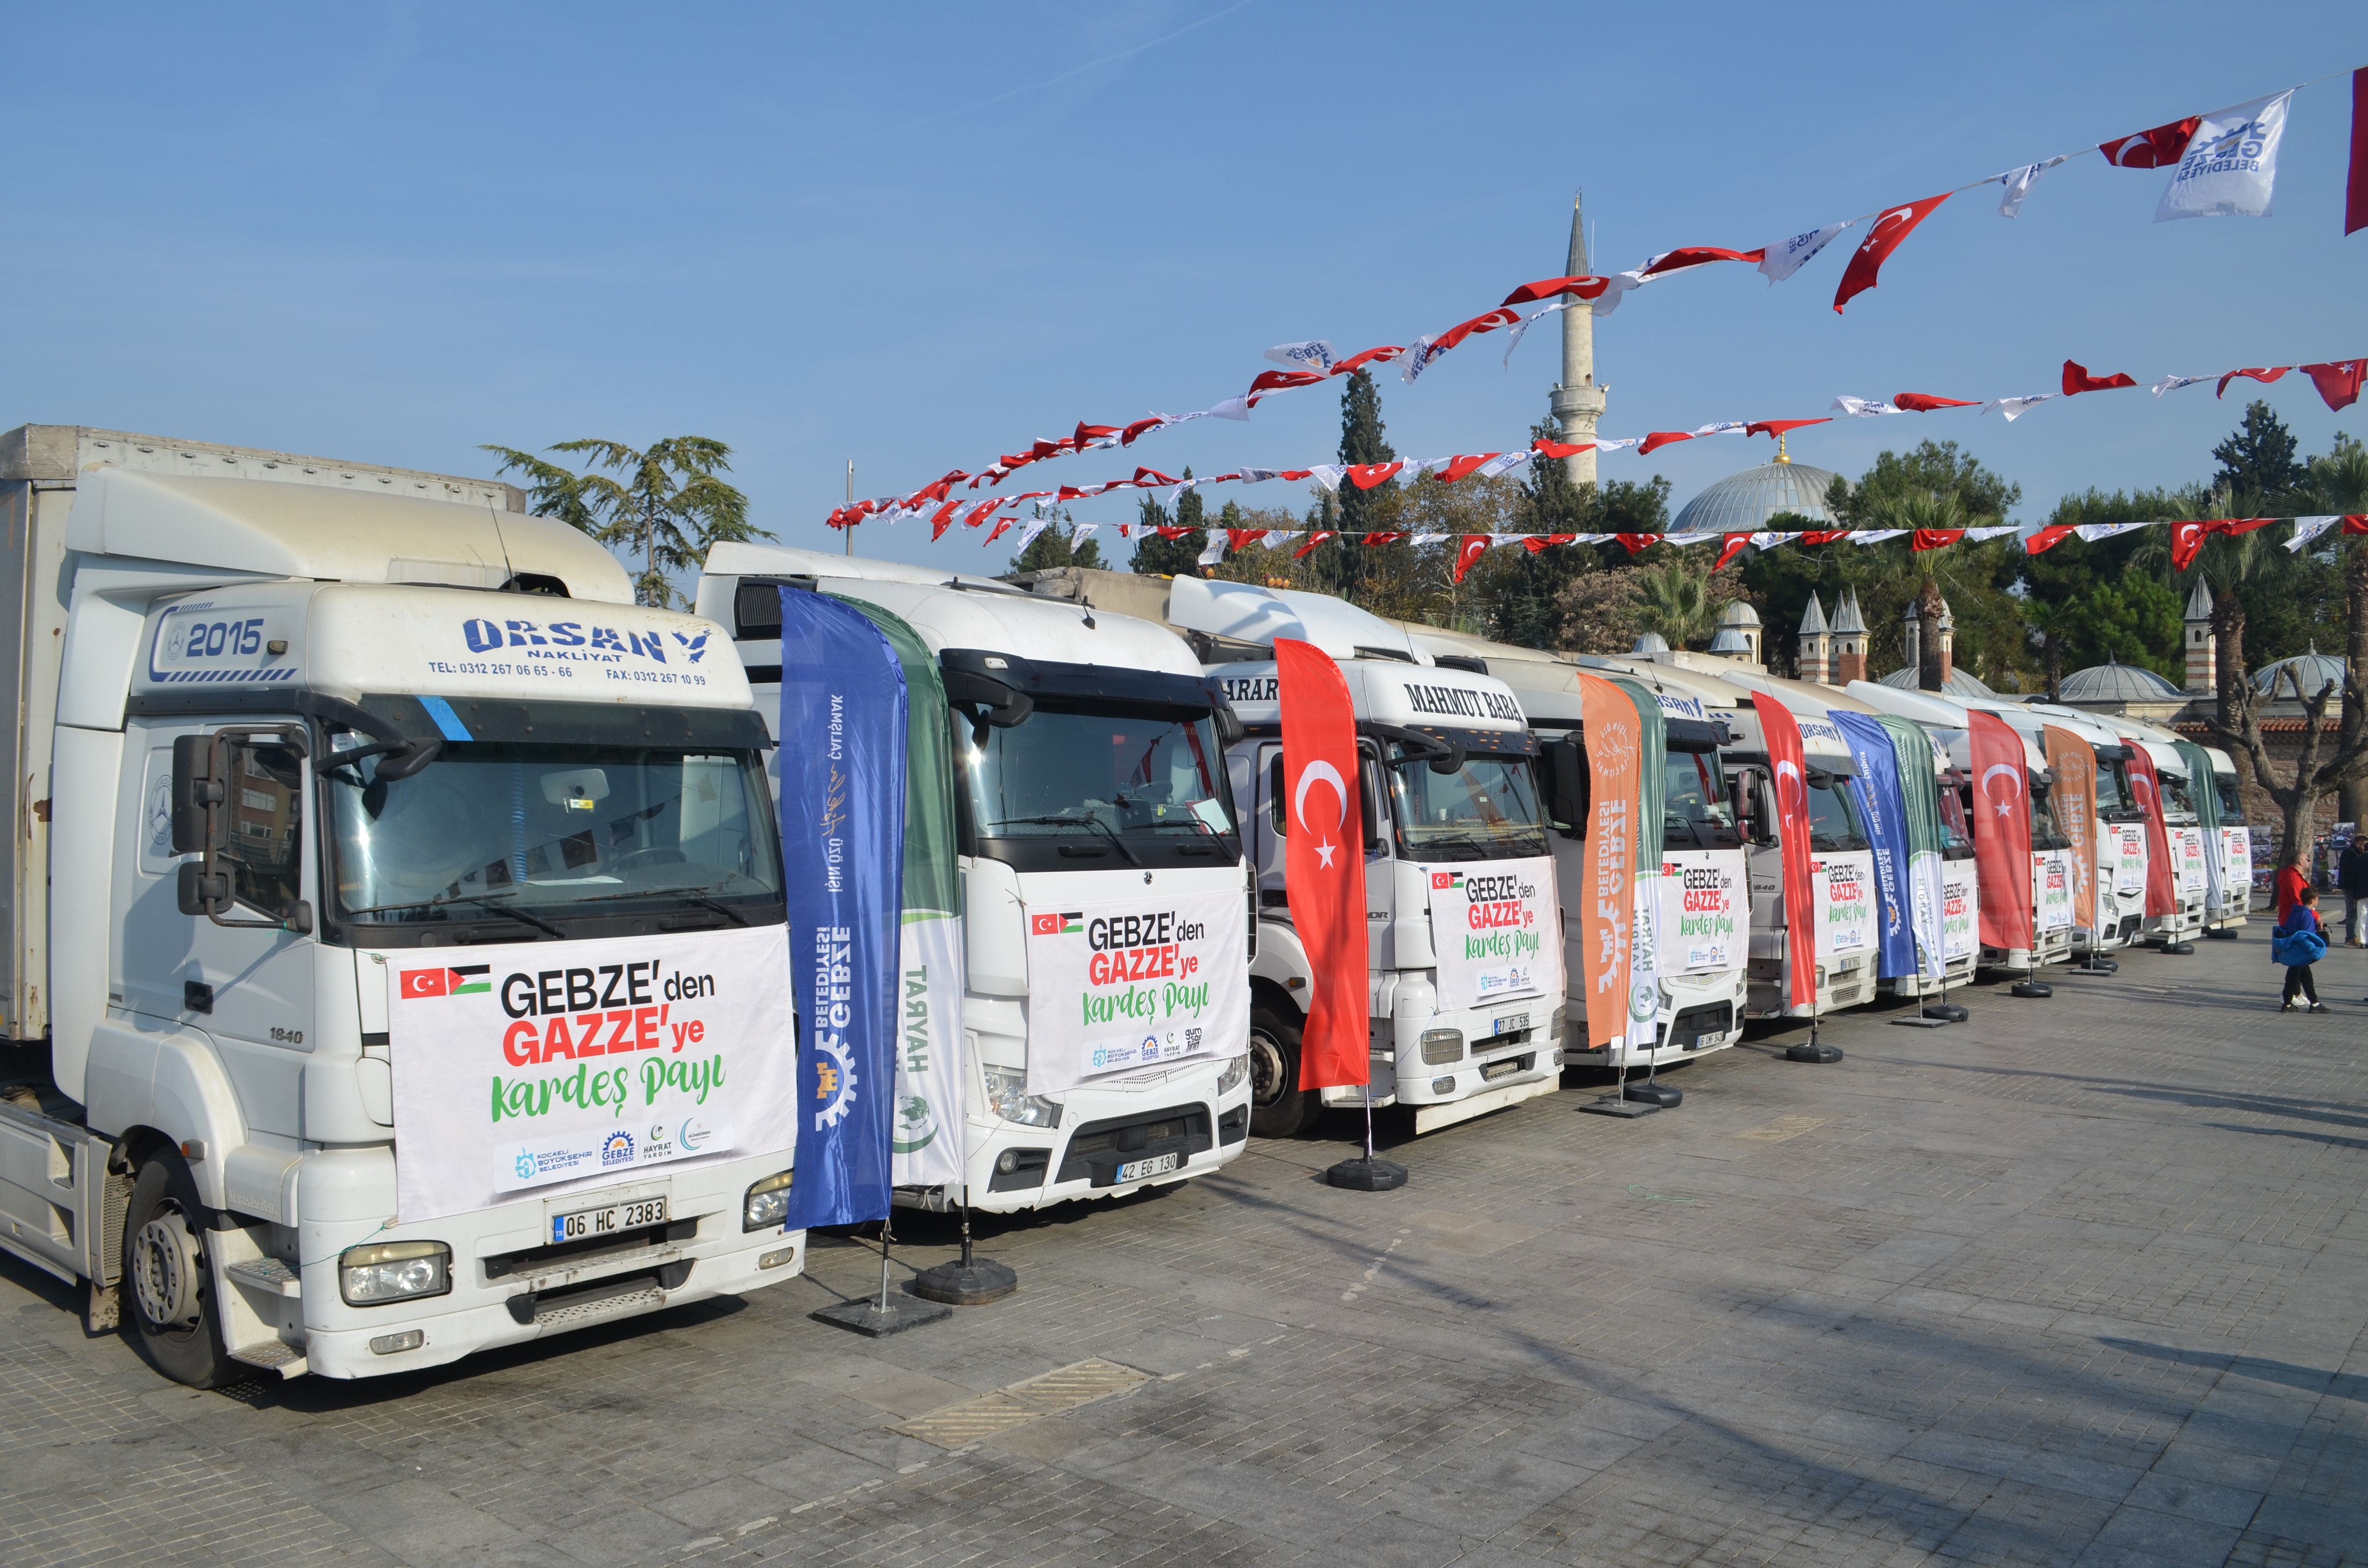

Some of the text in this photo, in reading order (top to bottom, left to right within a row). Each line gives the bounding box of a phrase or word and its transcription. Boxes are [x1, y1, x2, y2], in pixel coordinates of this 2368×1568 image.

[186, 618, 264, 657] 2015
[528, 649, 623, 662] NAKLİYAT
[429, 662, 457, 673] TEL:
[459, 662, 488, 674] 0312
[492, 663, 511, 675] 267
[516, 665, 532, 676] 06
[534, 665, 548, 677] 65
[558, 667, 573, 677] 66
[606, 669, 706, 686] FAX: 0312 267 10 99
[1404, 683, 1524, 723] MAHMUT BABA
[1498, 1015, 1529, 1032] 27 JC 535
[269, 1027, 304, 1044] 1840
[1142, 1047, 1159, 1056] GEBZE
[602, 1147, 635, 1160] GEBZE
[643, 1141, 672, 1153] HAYRAT
[538, 1151, 592, 1166] BÜYÜKŞEHİR
[602, 1156, 634, 1166] BELEDİYESİ
[643, 1150, 672, 1160] YARDIM
[1122, 1164, 1135, 1179] 42
[1141, 1160, 1153, 1176] EG
[1160, 1154, 1175, 1171] 130
[566, 1215, 586, 1237] 06
[596, 1209, 616, 1233] HC
[625, 1201, 664, 1226] 2383
